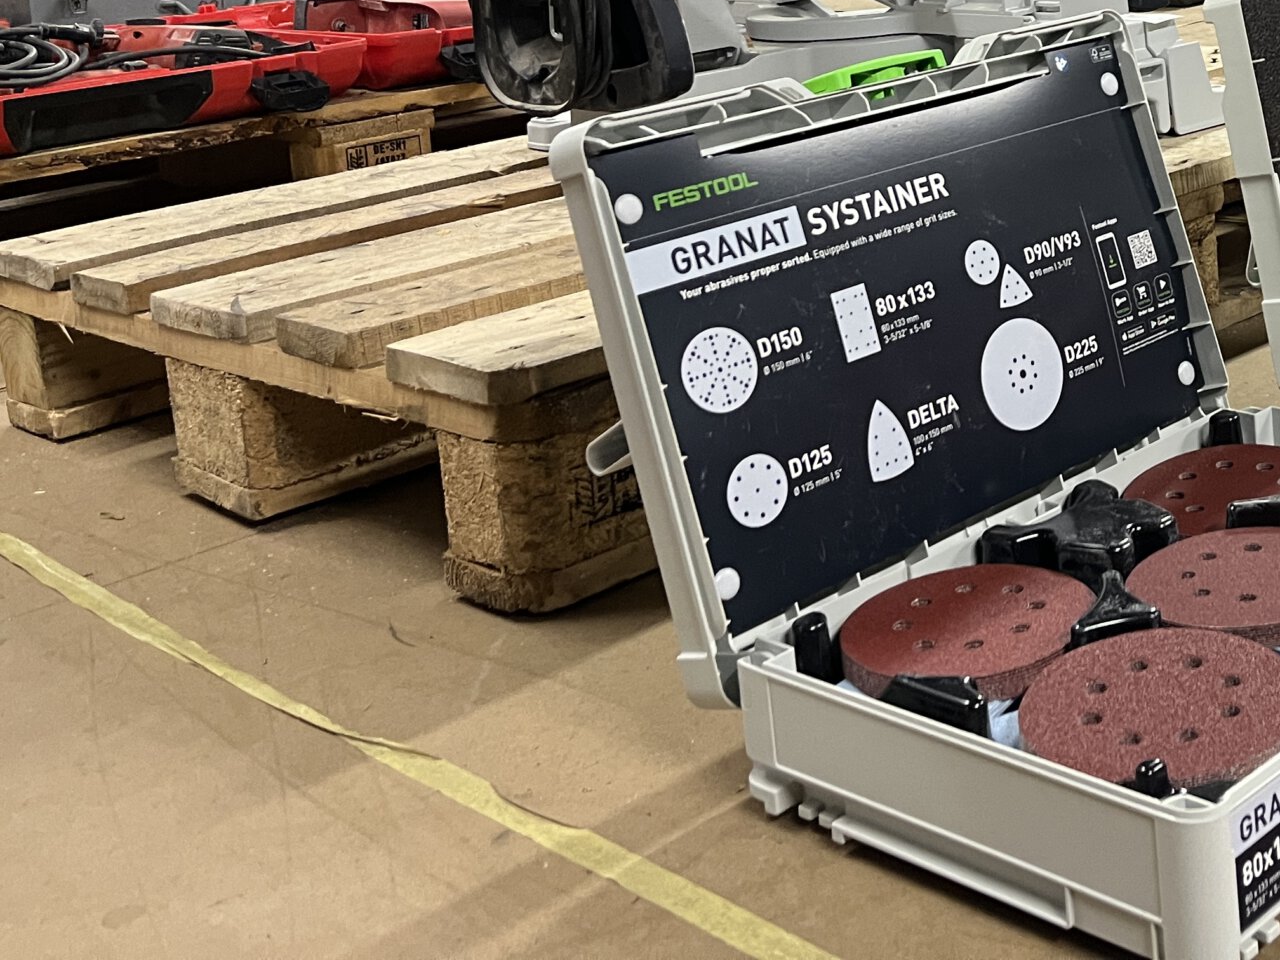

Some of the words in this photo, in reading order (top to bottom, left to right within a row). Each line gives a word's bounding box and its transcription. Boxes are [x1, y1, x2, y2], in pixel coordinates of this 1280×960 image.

[652, 172, 759, 212] FESTOOL
[670, 216, 790, 275] GRANAT
[806, 172, 950, 236] SYSTAINER
[680, 286, 703, 300] Your
[704, 272, 750, 293] abrasives
[749, 262, 780, 281] proper
[781, 252, 813, 270] sorted.
[812, 240, 850, 260] Equipped
[850, 235, 868, 248] with
[868, 234, 875, 242] a
[874, 228, 893, 240] wide
[893, 221, 915, 234] range
[915, 217, 924, 228] of
[937, 209, 958, 221] sizes.
[1023, 230, 1082, 265] D90/V93
[756, 326, 803, 359] D150
[1064, 335, 1099, 364] D225
[770, 360, 785, 373] 150
[785, 356, 801, 368] mm
[906, 394, 960, 430] DELTA
[788, 444, 833, 480] D125
[800, 480, 815, 493] 125
[815, 476, 830, 488] mm
